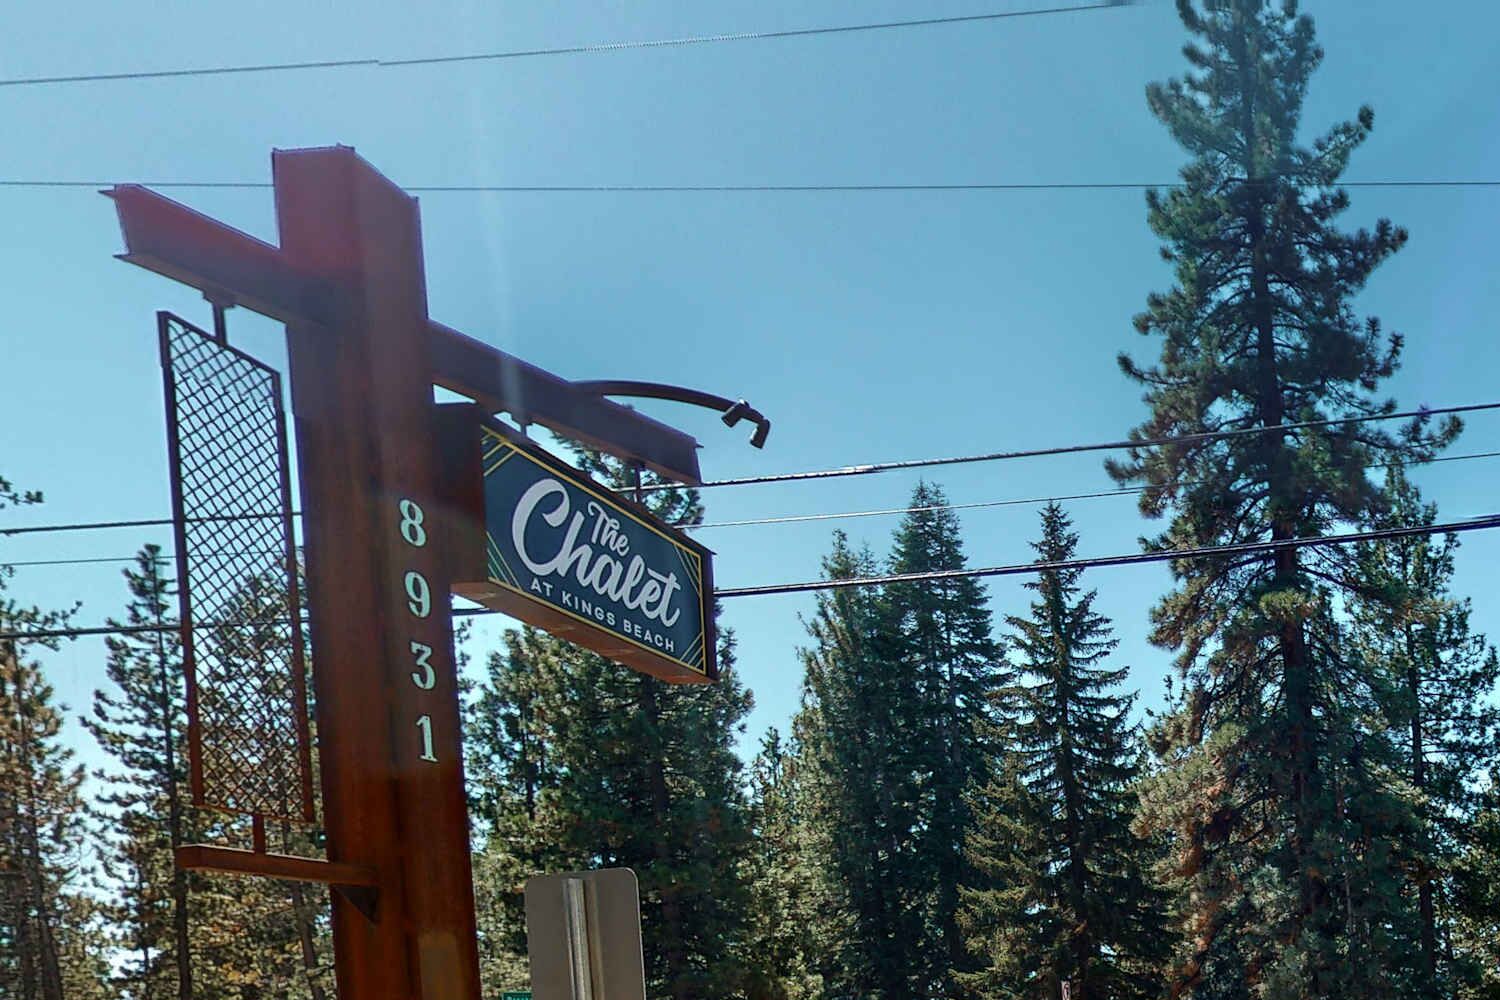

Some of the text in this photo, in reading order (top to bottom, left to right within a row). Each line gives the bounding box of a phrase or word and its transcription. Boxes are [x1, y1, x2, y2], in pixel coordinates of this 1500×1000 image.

[512, 478, 681, 627] Chalet
[587, 501, 630, 556] The
[399, 498, 438, 763] 8931
[530, 578, 674, 653] AT KINGS BEACH
